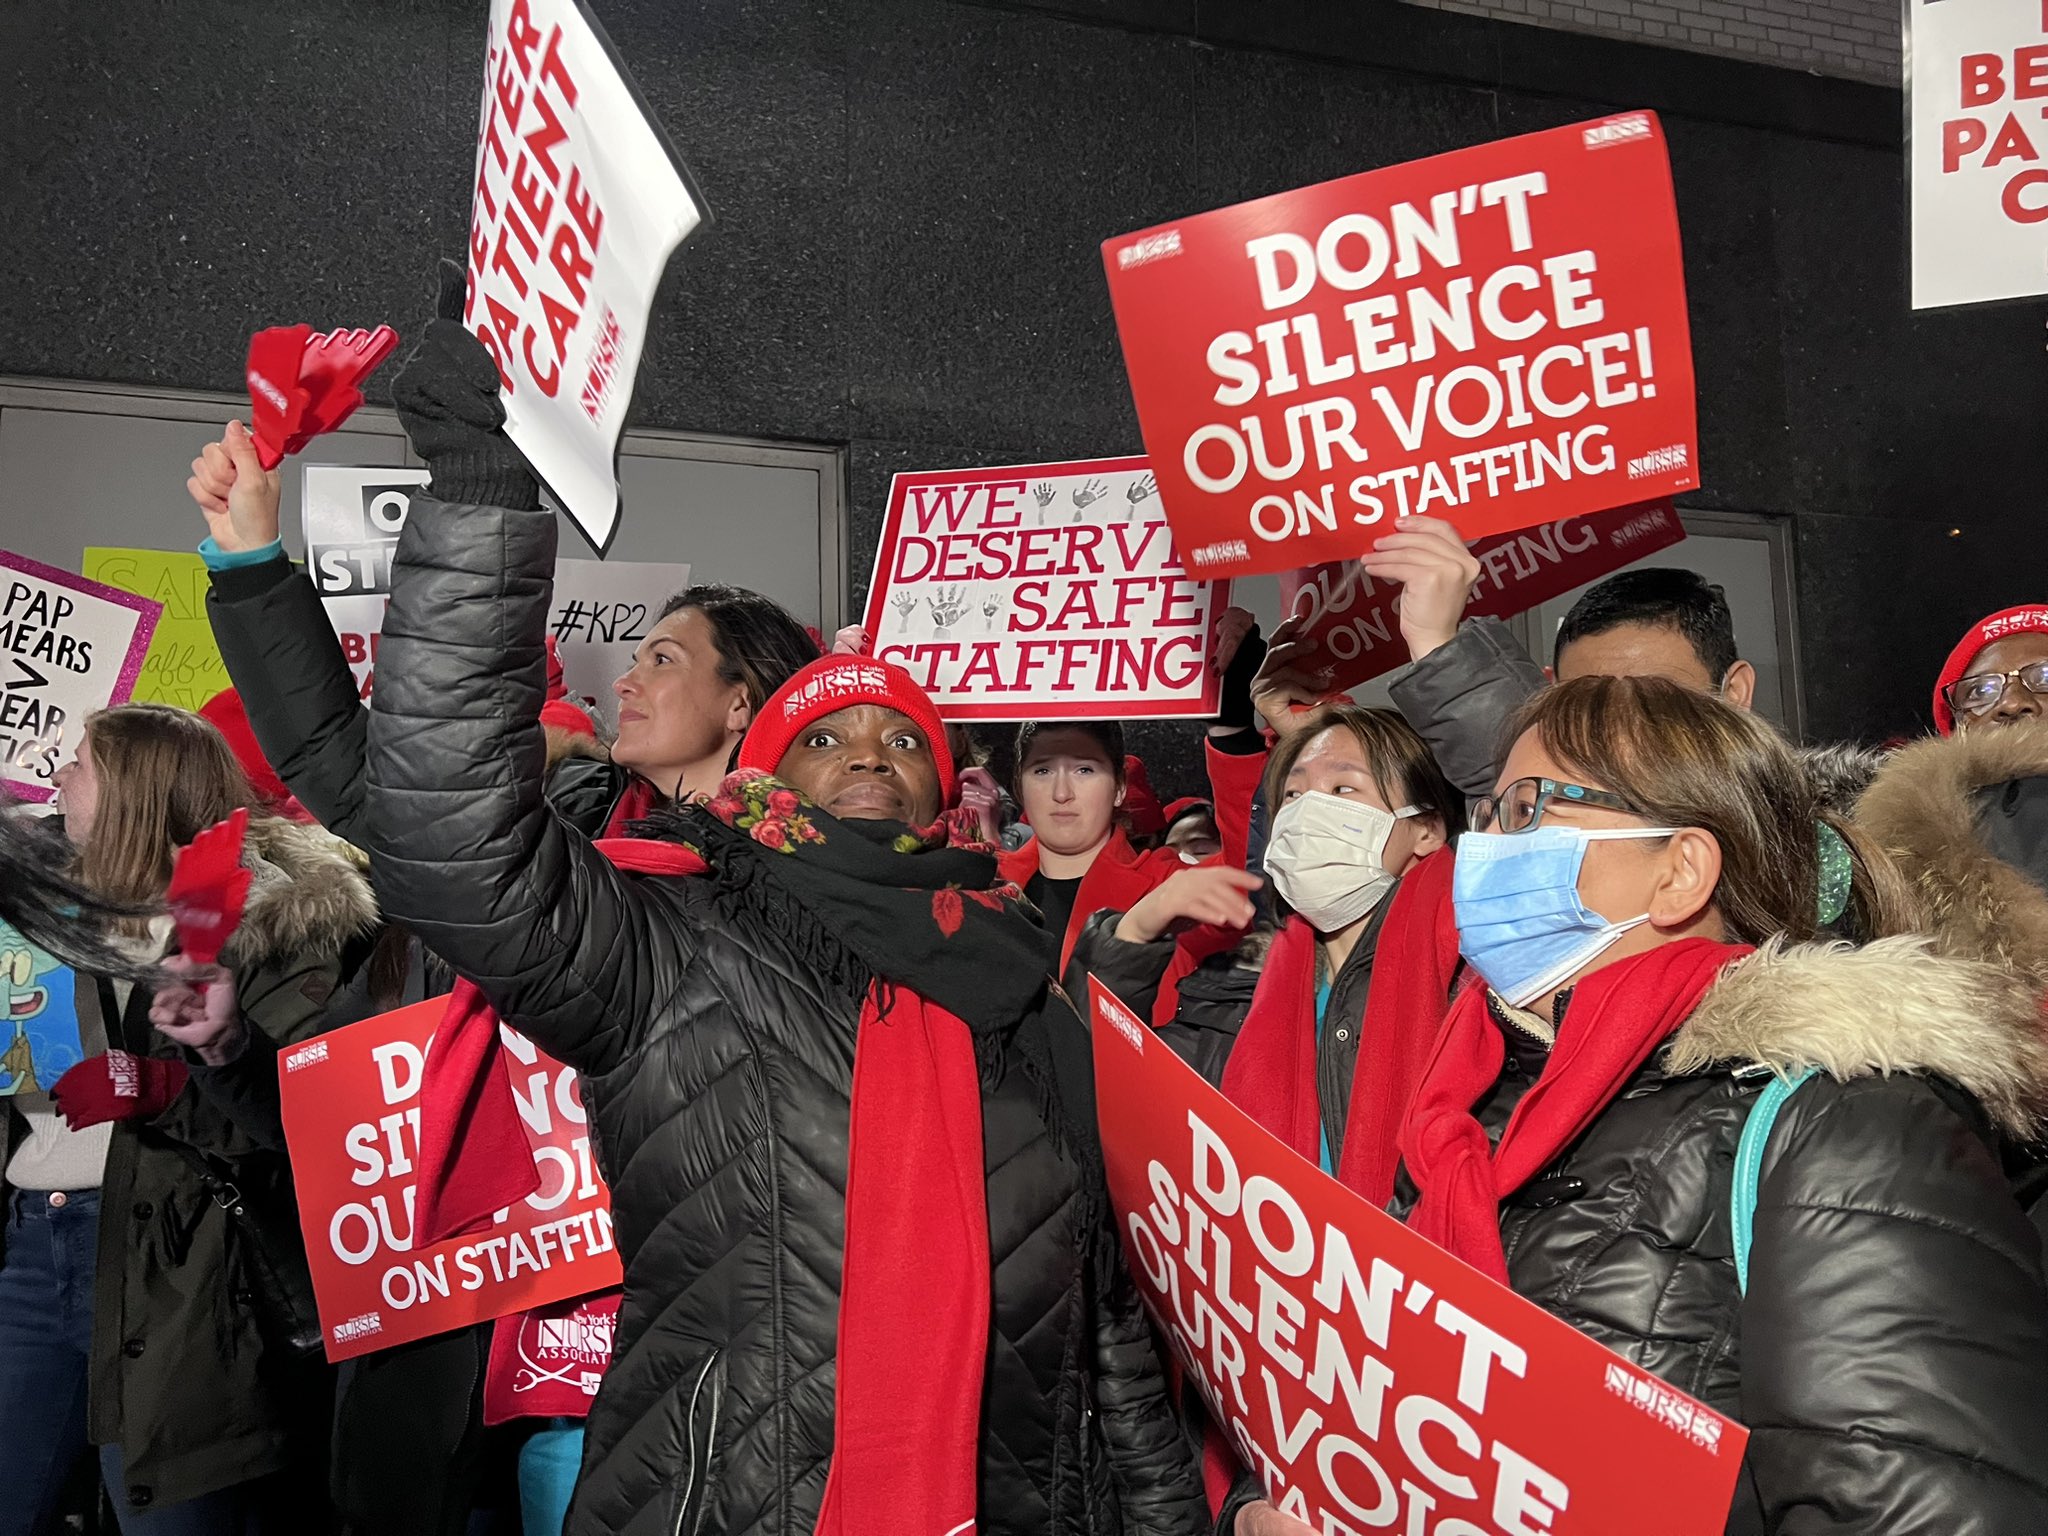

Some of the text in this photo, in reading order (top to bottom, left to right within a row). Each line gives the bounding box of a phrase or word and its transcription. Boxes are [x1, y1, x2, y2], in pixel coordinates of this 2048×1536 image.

[1245, 171, 1548, 311] DON'T
[522, 162, 605, 398] CARE
[1205, 250, 1604, 407] SILENCE
[1183, 327, 1657, 494] OUR VOICE!
[1249, 424, 1616, 542] ON STAFFING
[1627, 449, 1687, 475] NURSES
[908, 481, 1026, 533] WE
[3, 582, 74, 629] PAP
[1007, 576, 1204, 632] SAFE
[1327, 606, 1393, 660] ON
[0, 690, 67, 746] EAR
[783, 670, 887, 717] NURSES
[286, 1044, 328, 1068] NURSES
[329, 1186, 416, 1264] OU
[381, 1207, 615, 1310] ON STAFFIN
[1187, 1108, 1528, 1415] DON'T
[333, 1315, 380, 1338] NURSES
[587, 1313, 611, 1325] York
[1128, 1211, 1249, 1417] OUR
[1147, 1159, 1570, 1536] SILENCE
[537, 1347, 608, 1365] ASSOCIAT
[1605, 1362, 1722, 1445] NURSES
